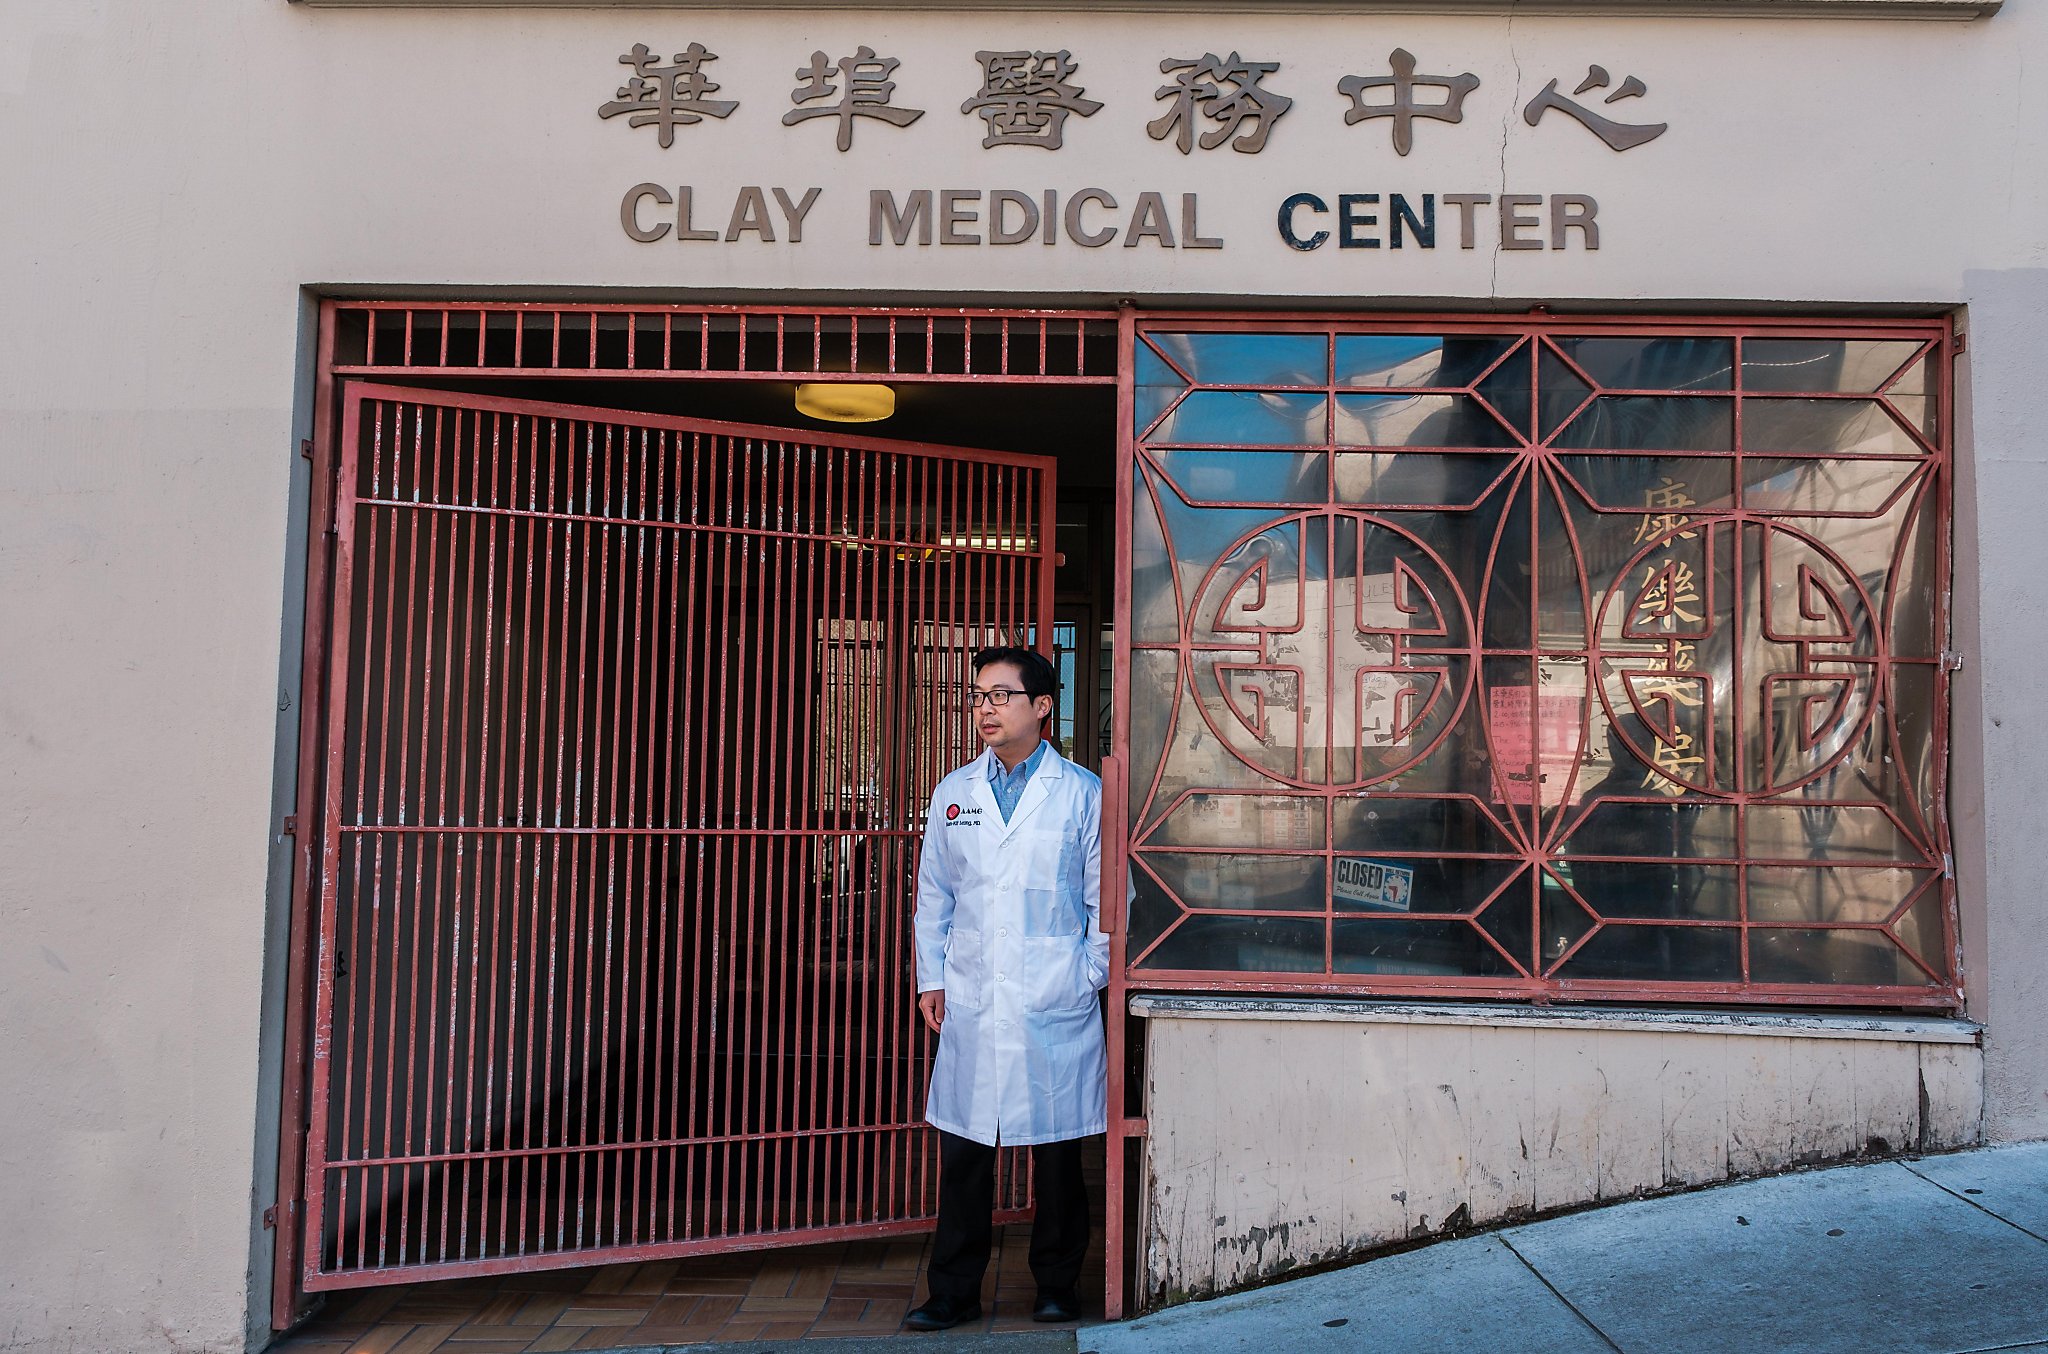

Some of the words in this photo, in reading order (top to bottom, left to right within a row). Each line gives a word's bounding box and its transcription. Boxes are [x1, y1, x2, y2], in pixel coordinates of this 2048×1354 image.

[598, 42, 1667, 156] 華埠醫務中心
[620, 182, 822, 243] CLAY
[869, 187, 1223, 250] MEDICAL
[1278, 192, 1600, 252] CENTER
[1338, 860, 1383, 890] CLOSED
[1353, 889, 1364, 897] Call
